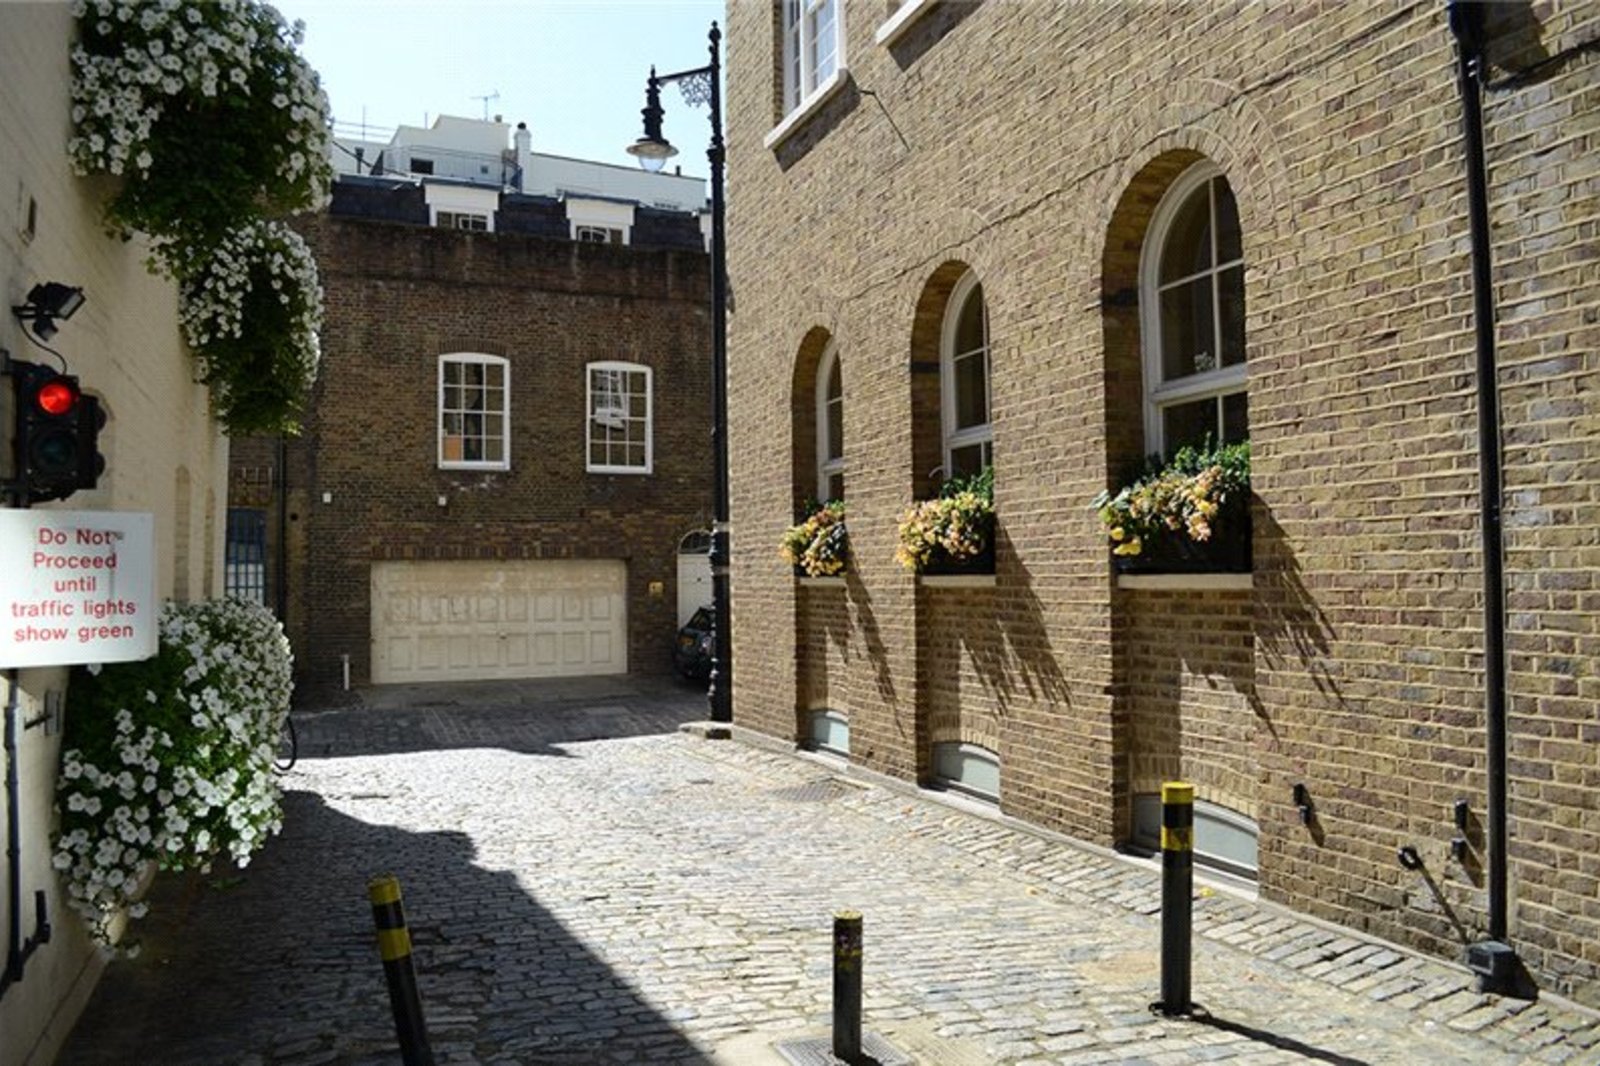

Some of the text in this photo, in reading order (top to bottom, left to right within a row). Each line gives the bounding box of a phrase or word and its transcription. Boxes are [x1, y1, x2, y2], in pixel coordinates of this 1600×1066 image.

[39, 528, 111, 545] Do Not
[33, 552, 117, 569] Proceed
[54, 576, 96, 593] until
[11, 600, 136, 619] traffic lights
[14, 625, 133, 642] show green
